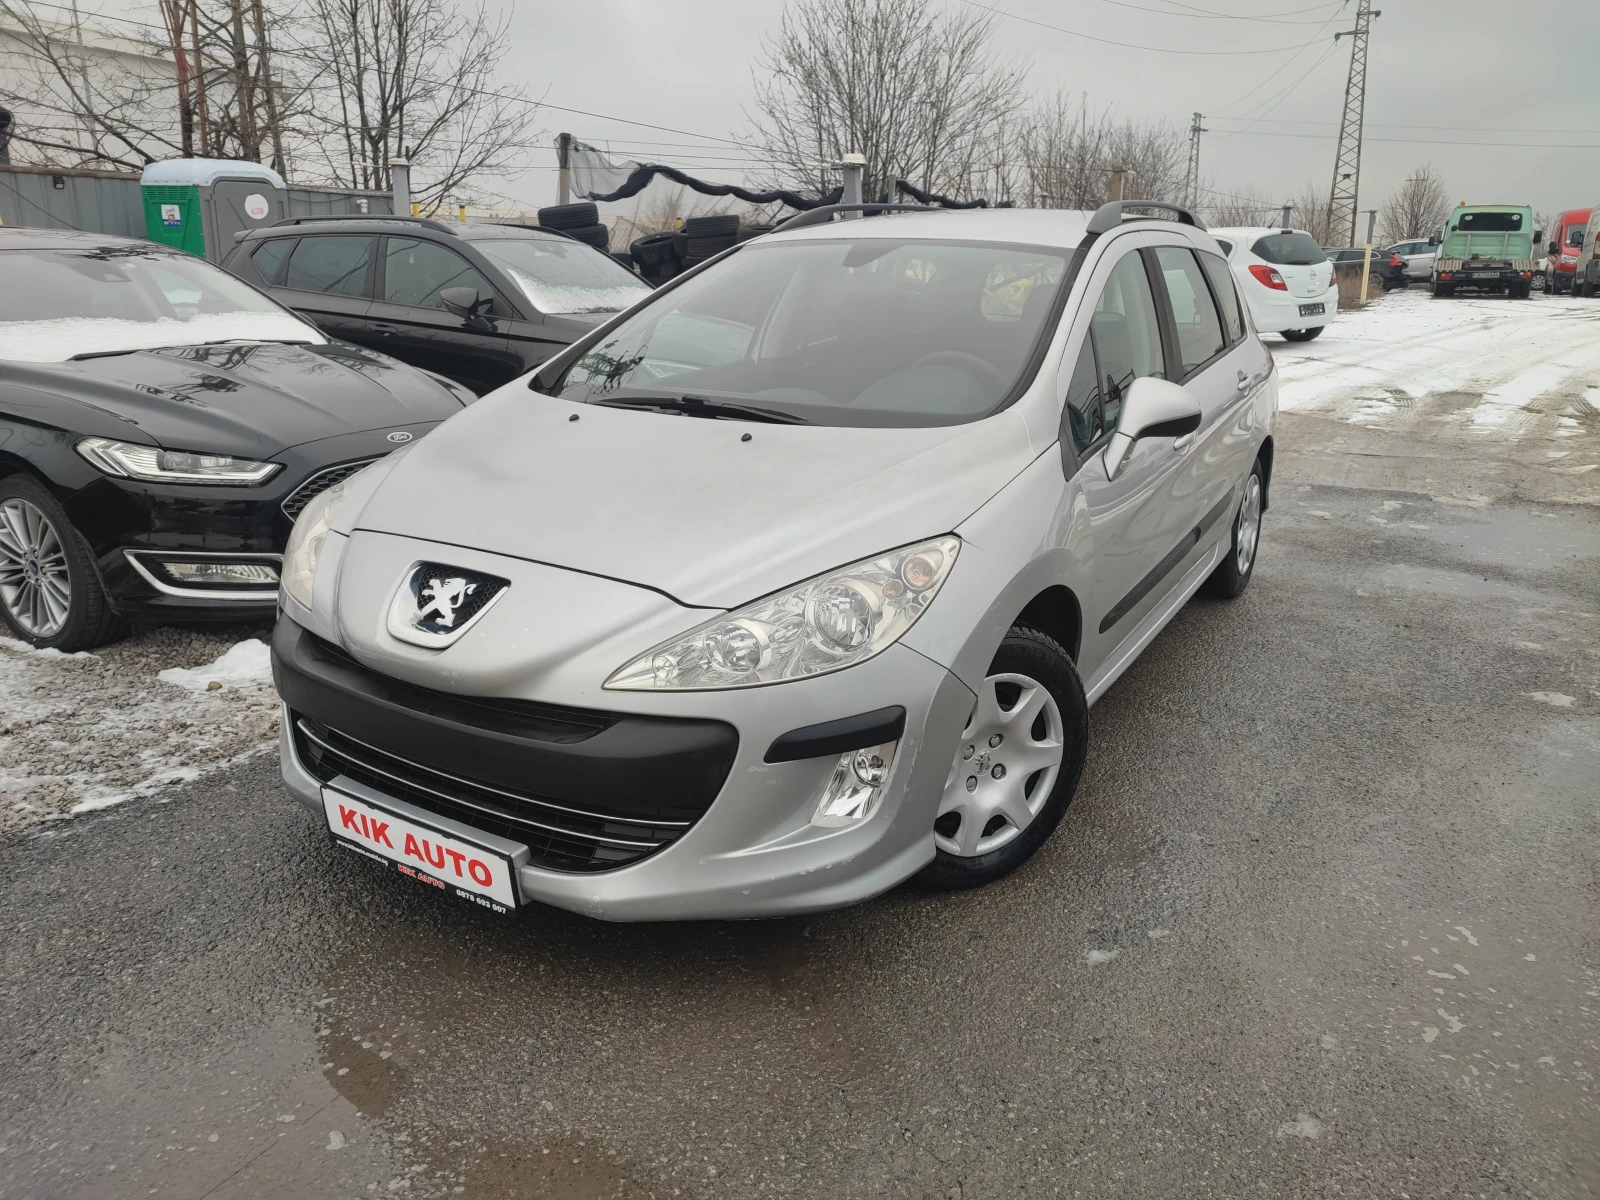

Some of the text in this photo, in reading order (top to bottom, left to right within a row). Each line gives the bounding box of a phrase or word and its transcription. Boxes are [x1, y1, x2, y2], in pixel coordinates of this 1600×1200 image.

[392, 433, 409, 441] Ford
[338, 804, 493, 887] KIK AUTO
[397, 863, 446, 890] KIK AUTO
[492, 903, 507, 914] 007
